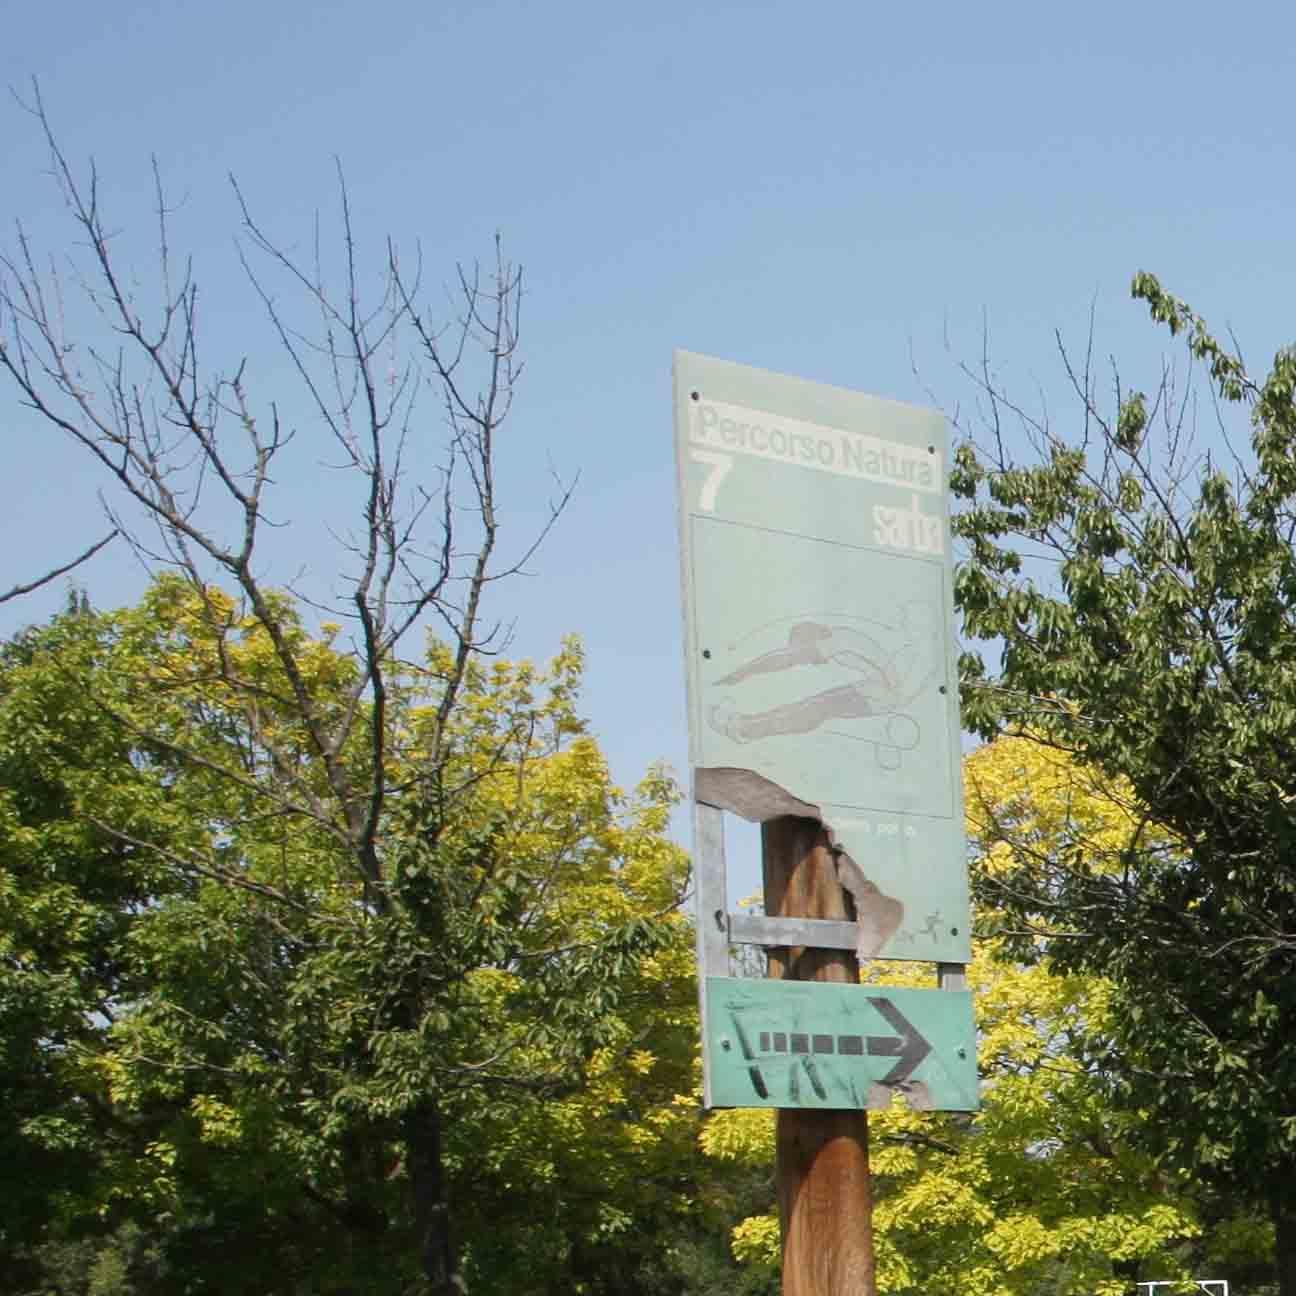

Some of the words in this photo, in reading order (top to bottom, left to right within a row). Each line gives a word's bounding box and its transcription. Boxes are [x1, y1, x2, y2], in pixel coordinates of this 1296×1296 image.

[689, 449, 732, 512] 7
[699, 405, 836, 468] Percorso
[841, 435, 934, 486] Natura
